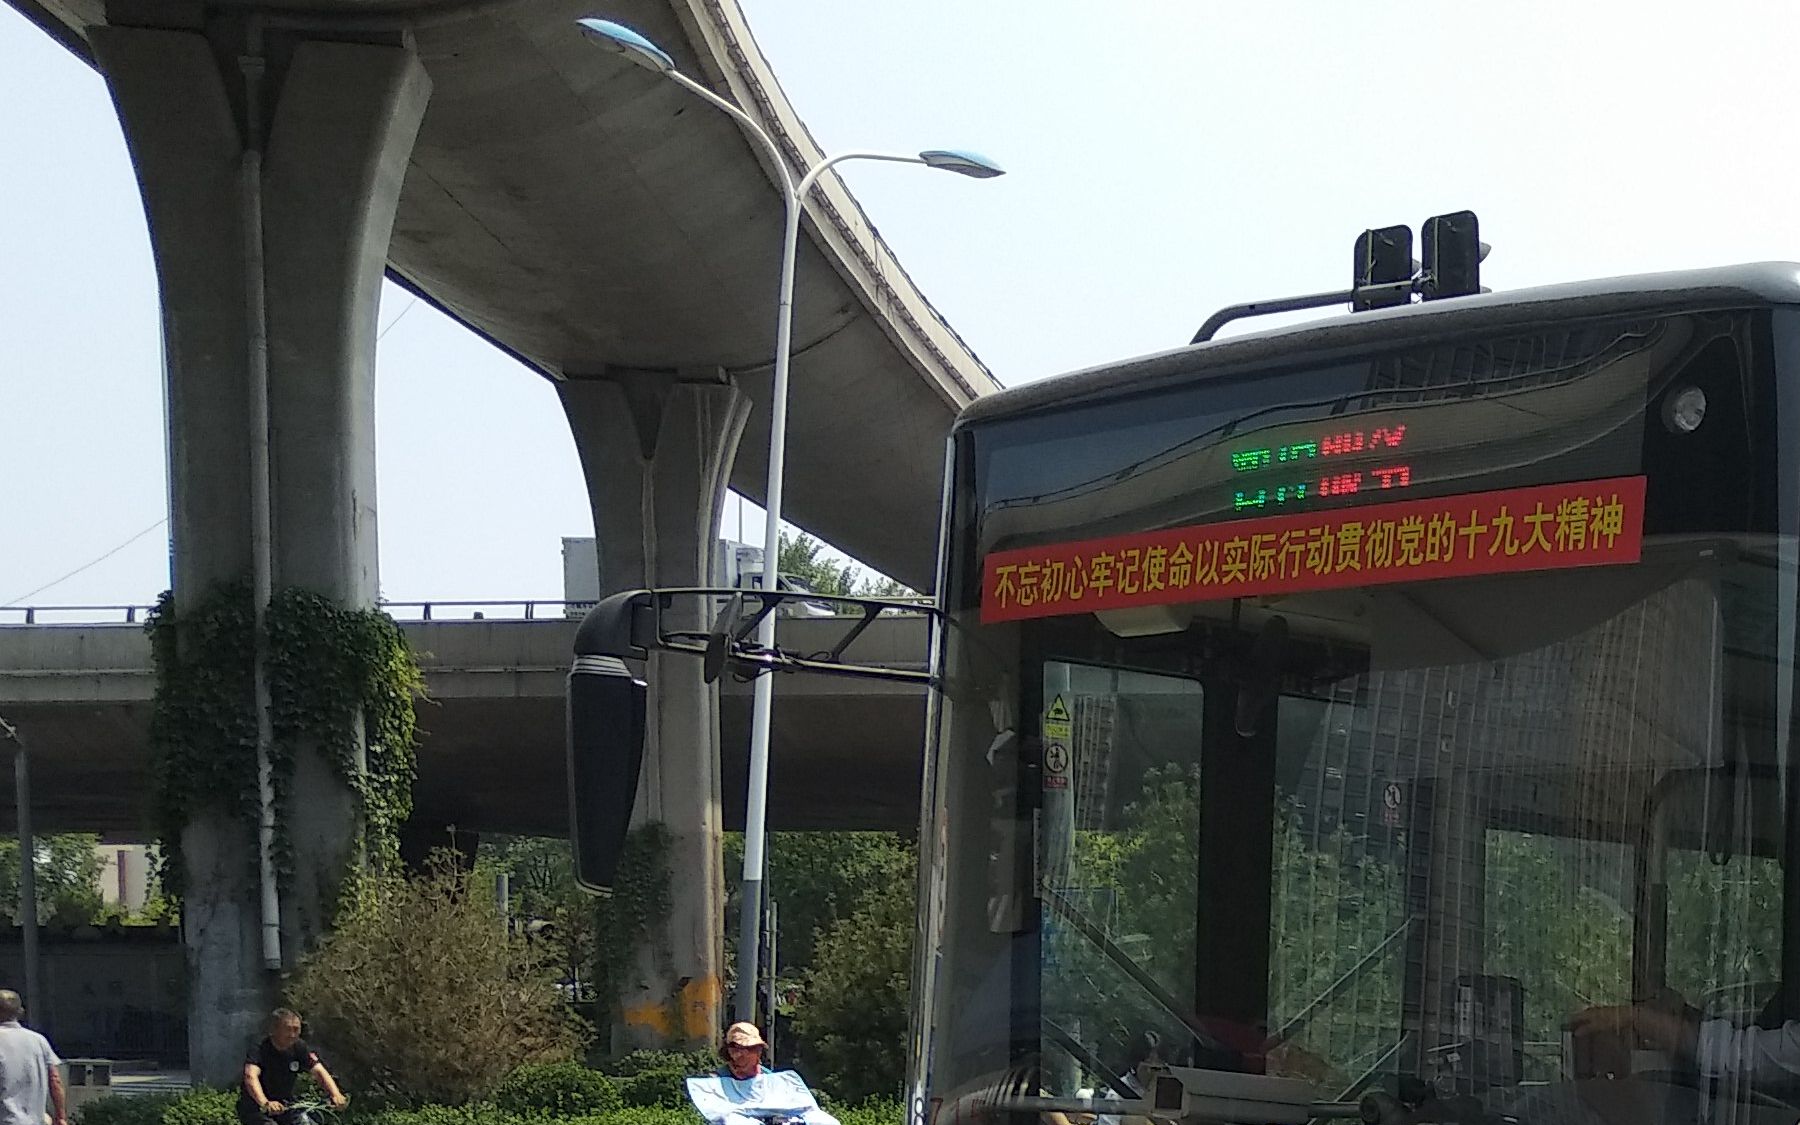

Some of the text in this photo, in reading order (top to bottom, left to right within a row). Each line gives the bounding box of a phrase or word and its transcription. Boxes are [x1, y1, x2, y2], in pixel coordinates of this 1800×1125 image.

[993, 493, 1625, 609] 不忘初心牢记使命以实际行动贯彻党的十九大精神
